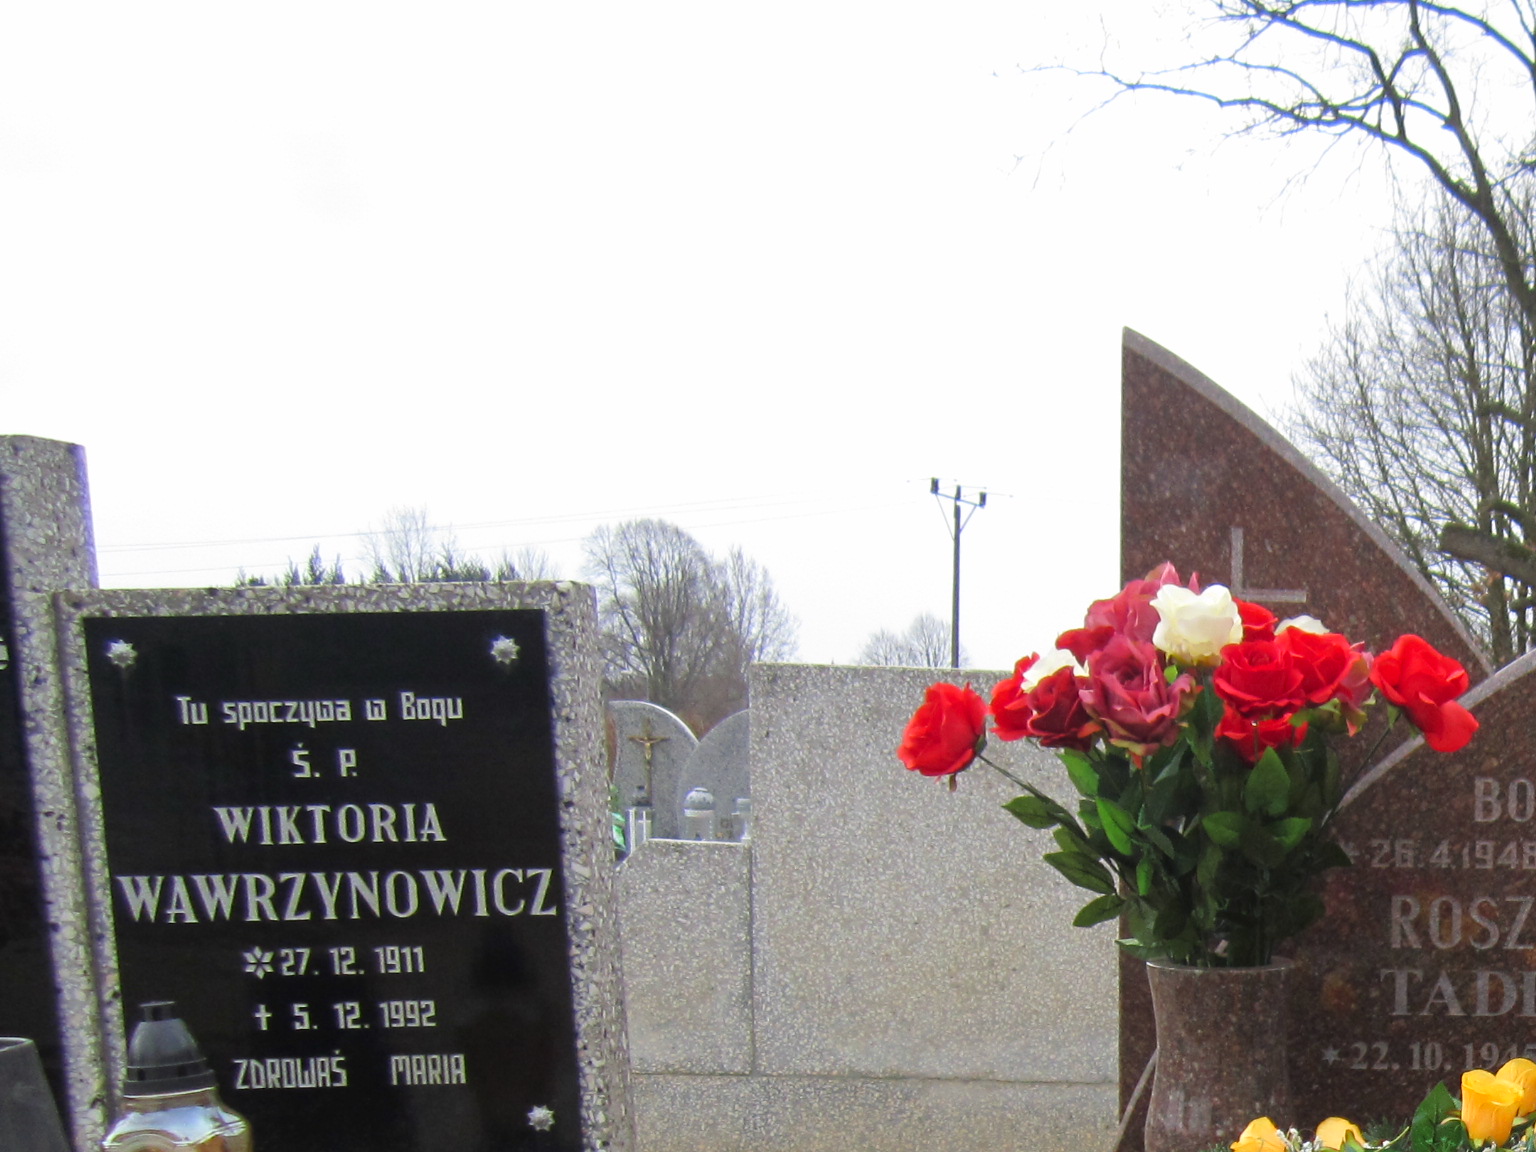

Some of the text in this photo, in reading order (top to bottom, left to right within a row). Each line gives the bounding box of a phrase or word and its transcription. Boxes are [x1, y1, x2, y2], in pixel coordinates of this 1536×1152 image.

[176, 695, 208, 725] Tu
[222, 699, 352, 731] spoczywa
[365, 699, 387, 721] w
[213, 803, 446, 845] WIKTORIA
[116, 868, 558, 923] WAWRZYNOWICZ
[233, 1049, 467, 1090] ZDROWAŚ MARIA
